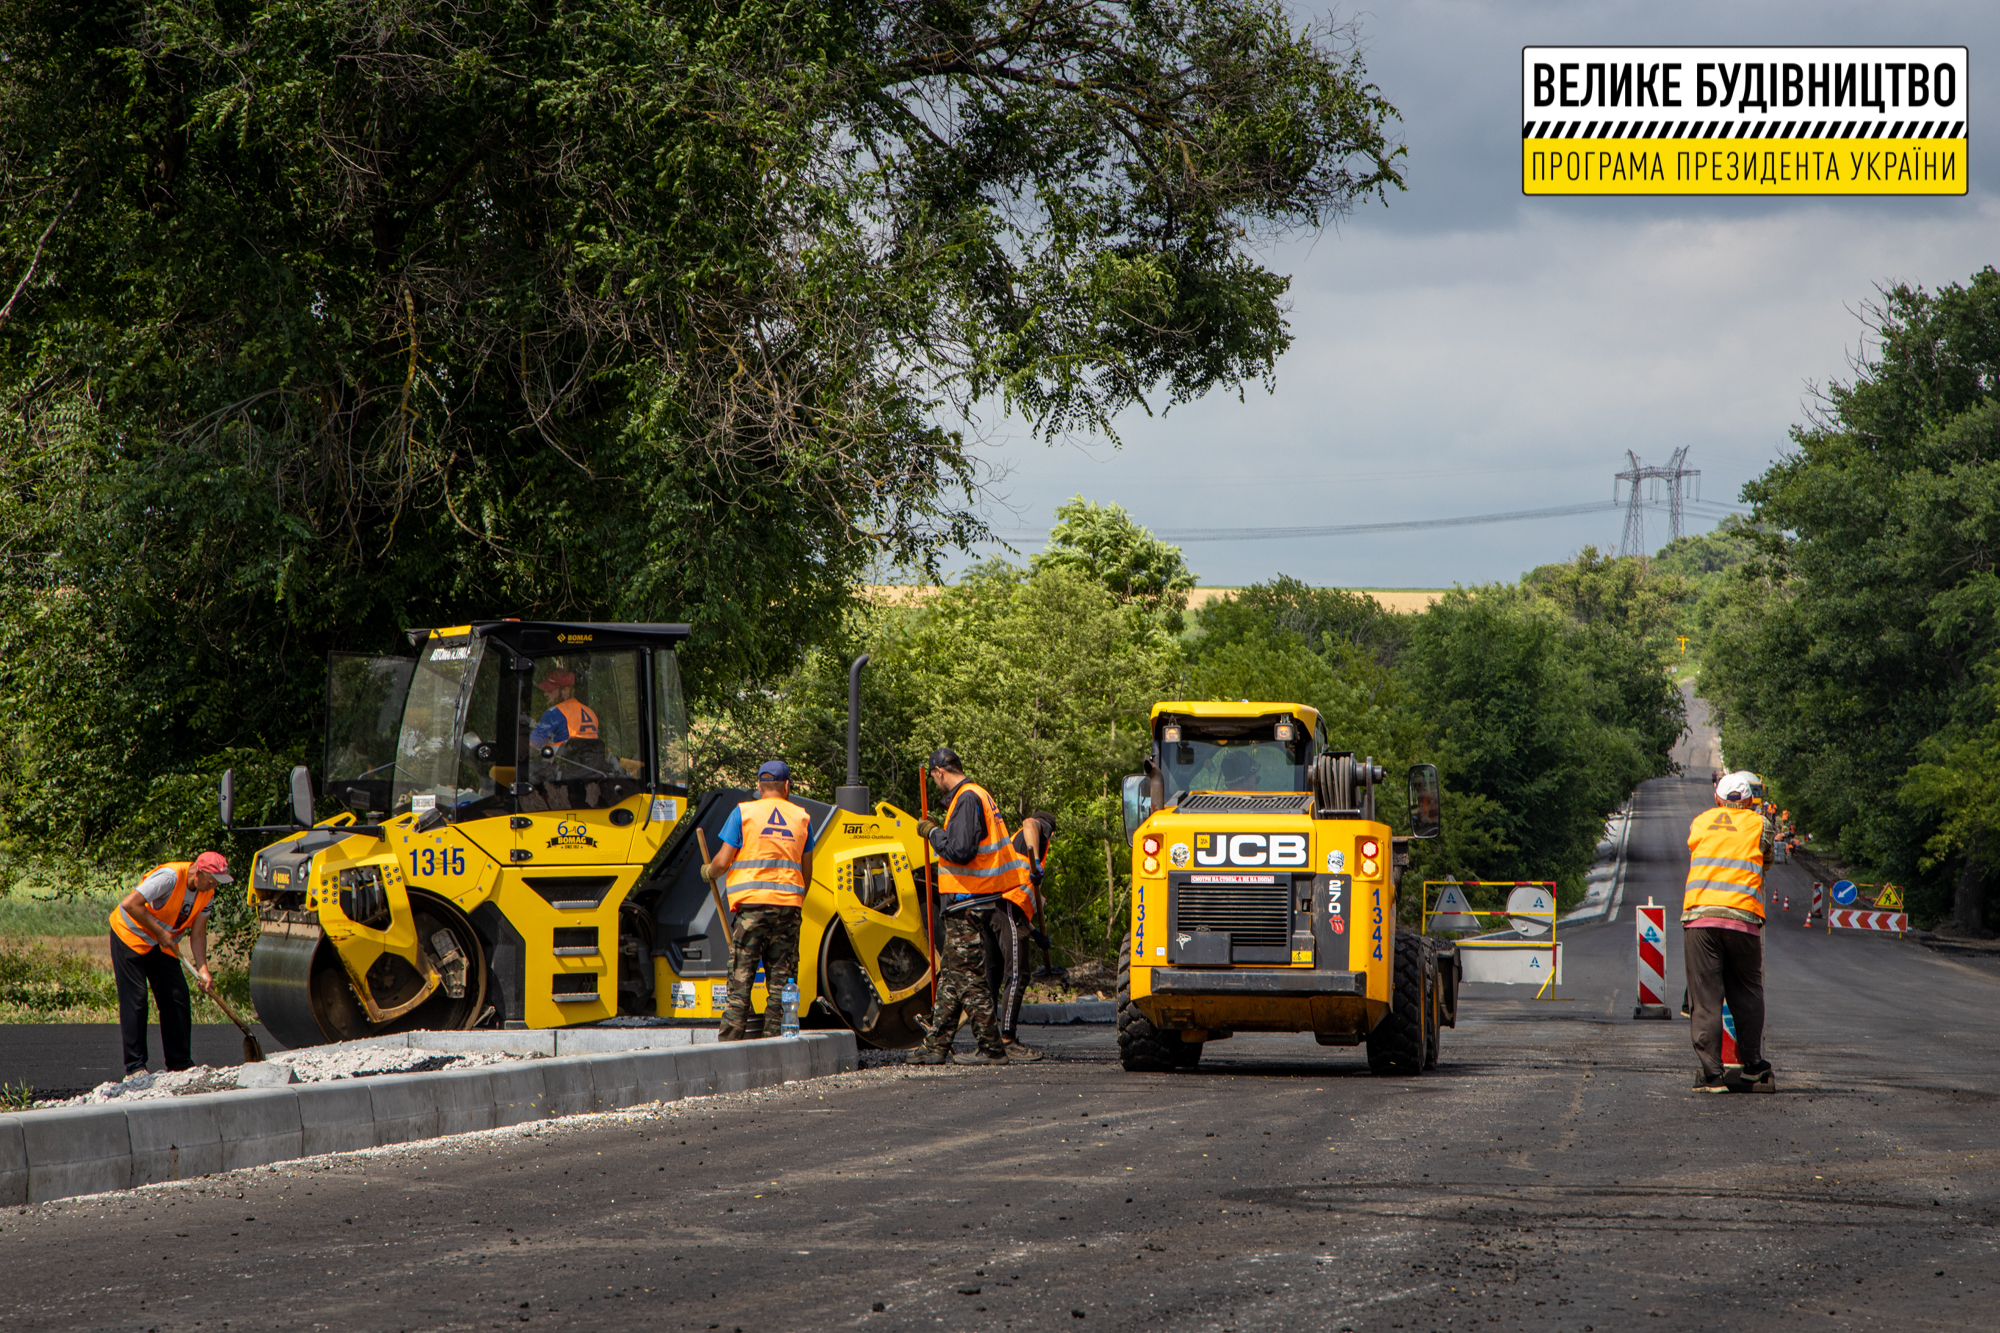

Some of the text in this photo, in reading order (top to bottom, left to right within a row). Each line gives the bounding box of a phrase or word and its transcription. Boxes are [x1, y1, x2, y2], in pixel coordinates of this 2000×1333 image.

[557, 836, 587, 844] BOMAG
[1196, 834, 1306, 866] JCB
[409, 848, 465, 877] 1315
[1328, 879, 1342, 914] 270
[1135, 885, 1146, 958] 1344
[1372, 888, 1383, 962] 1344
